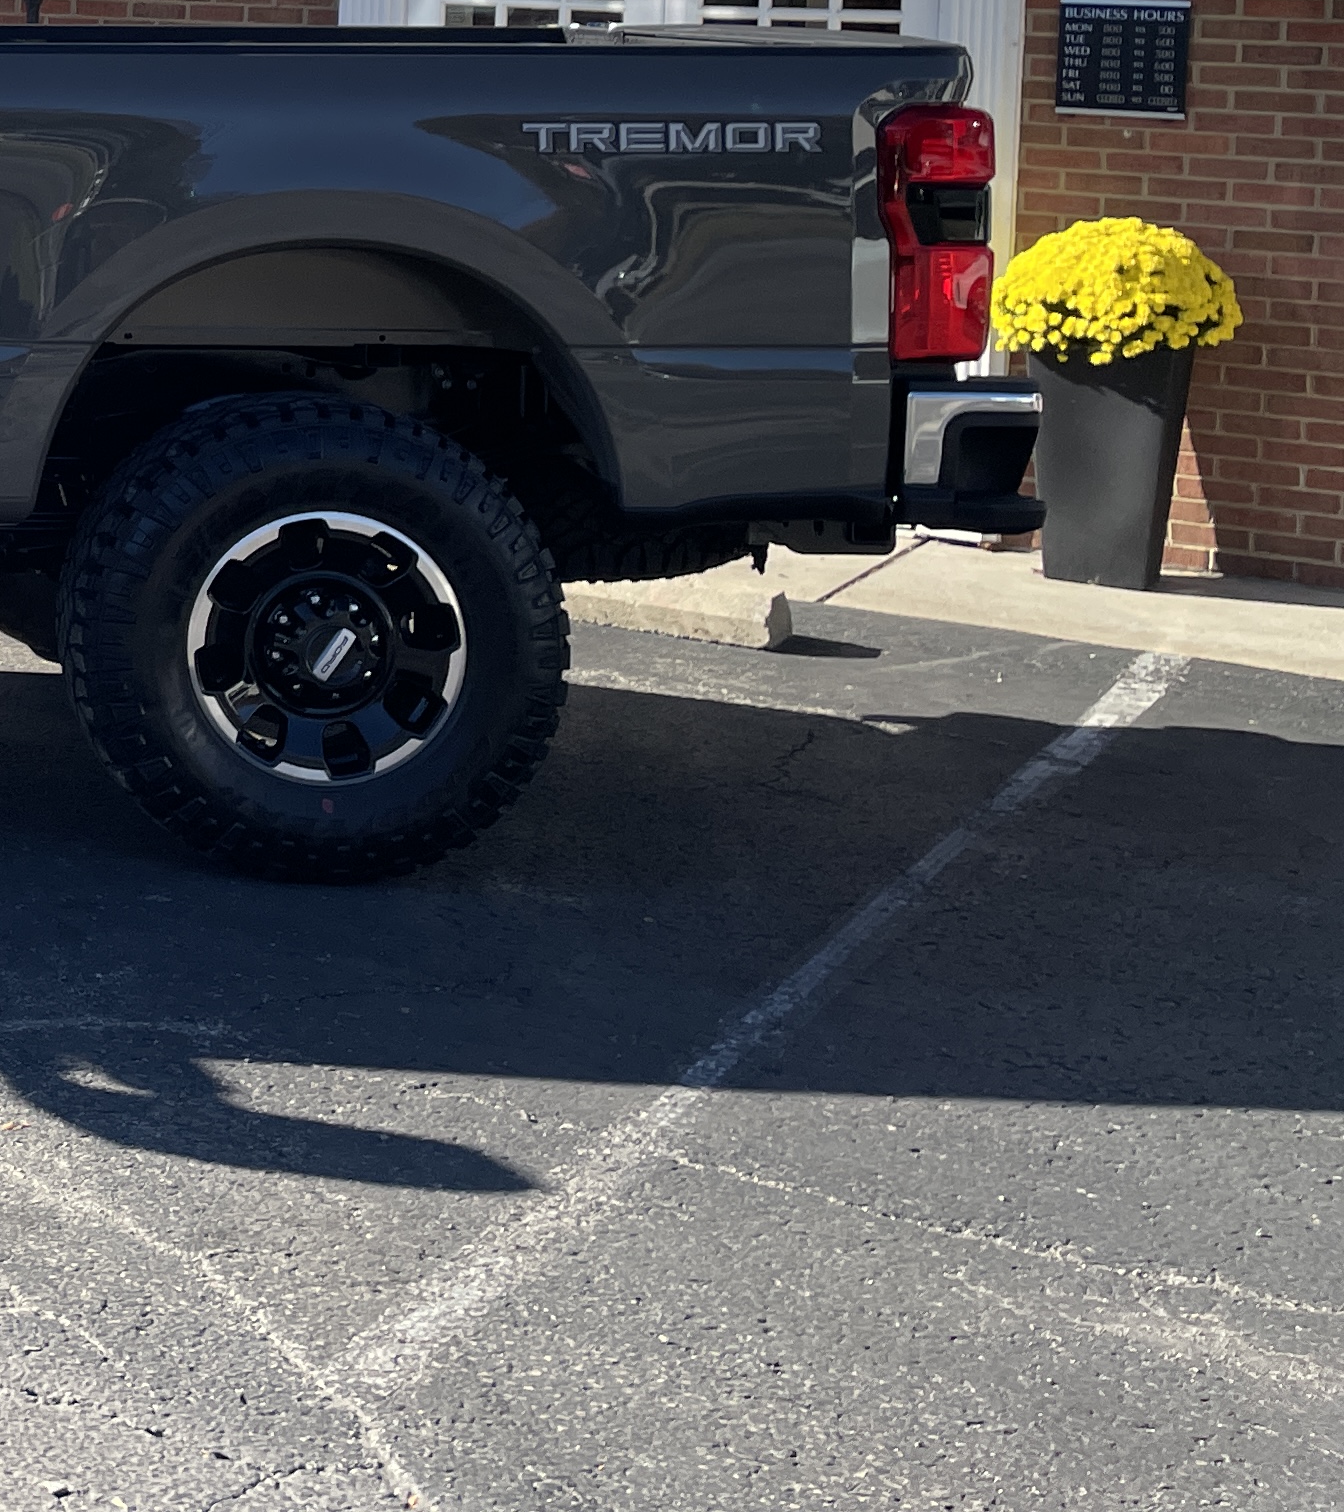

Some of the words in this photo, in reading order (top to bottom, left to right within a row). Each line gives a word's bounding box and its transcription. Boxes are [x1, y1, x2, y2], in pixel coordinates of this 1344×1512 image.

[1065, 7, 1128, 20] BUSINESS
[1134, 10, 1185, 22] HOURS
[1065, 23, 1093, 33] MON
[1065, 34, 1085, 44] TUE
[1064, 46, 1090, 56] WED
[1064, 57, 1087, 67] THU
[1062, 68, 1079, 78] FRI
[1062, 80, 1081, 90] SAT
[1062, 92, 1084, 102] SUN
[522, 122, 822, 153] TREMOR
[320, 635, 349, 674] FORD
